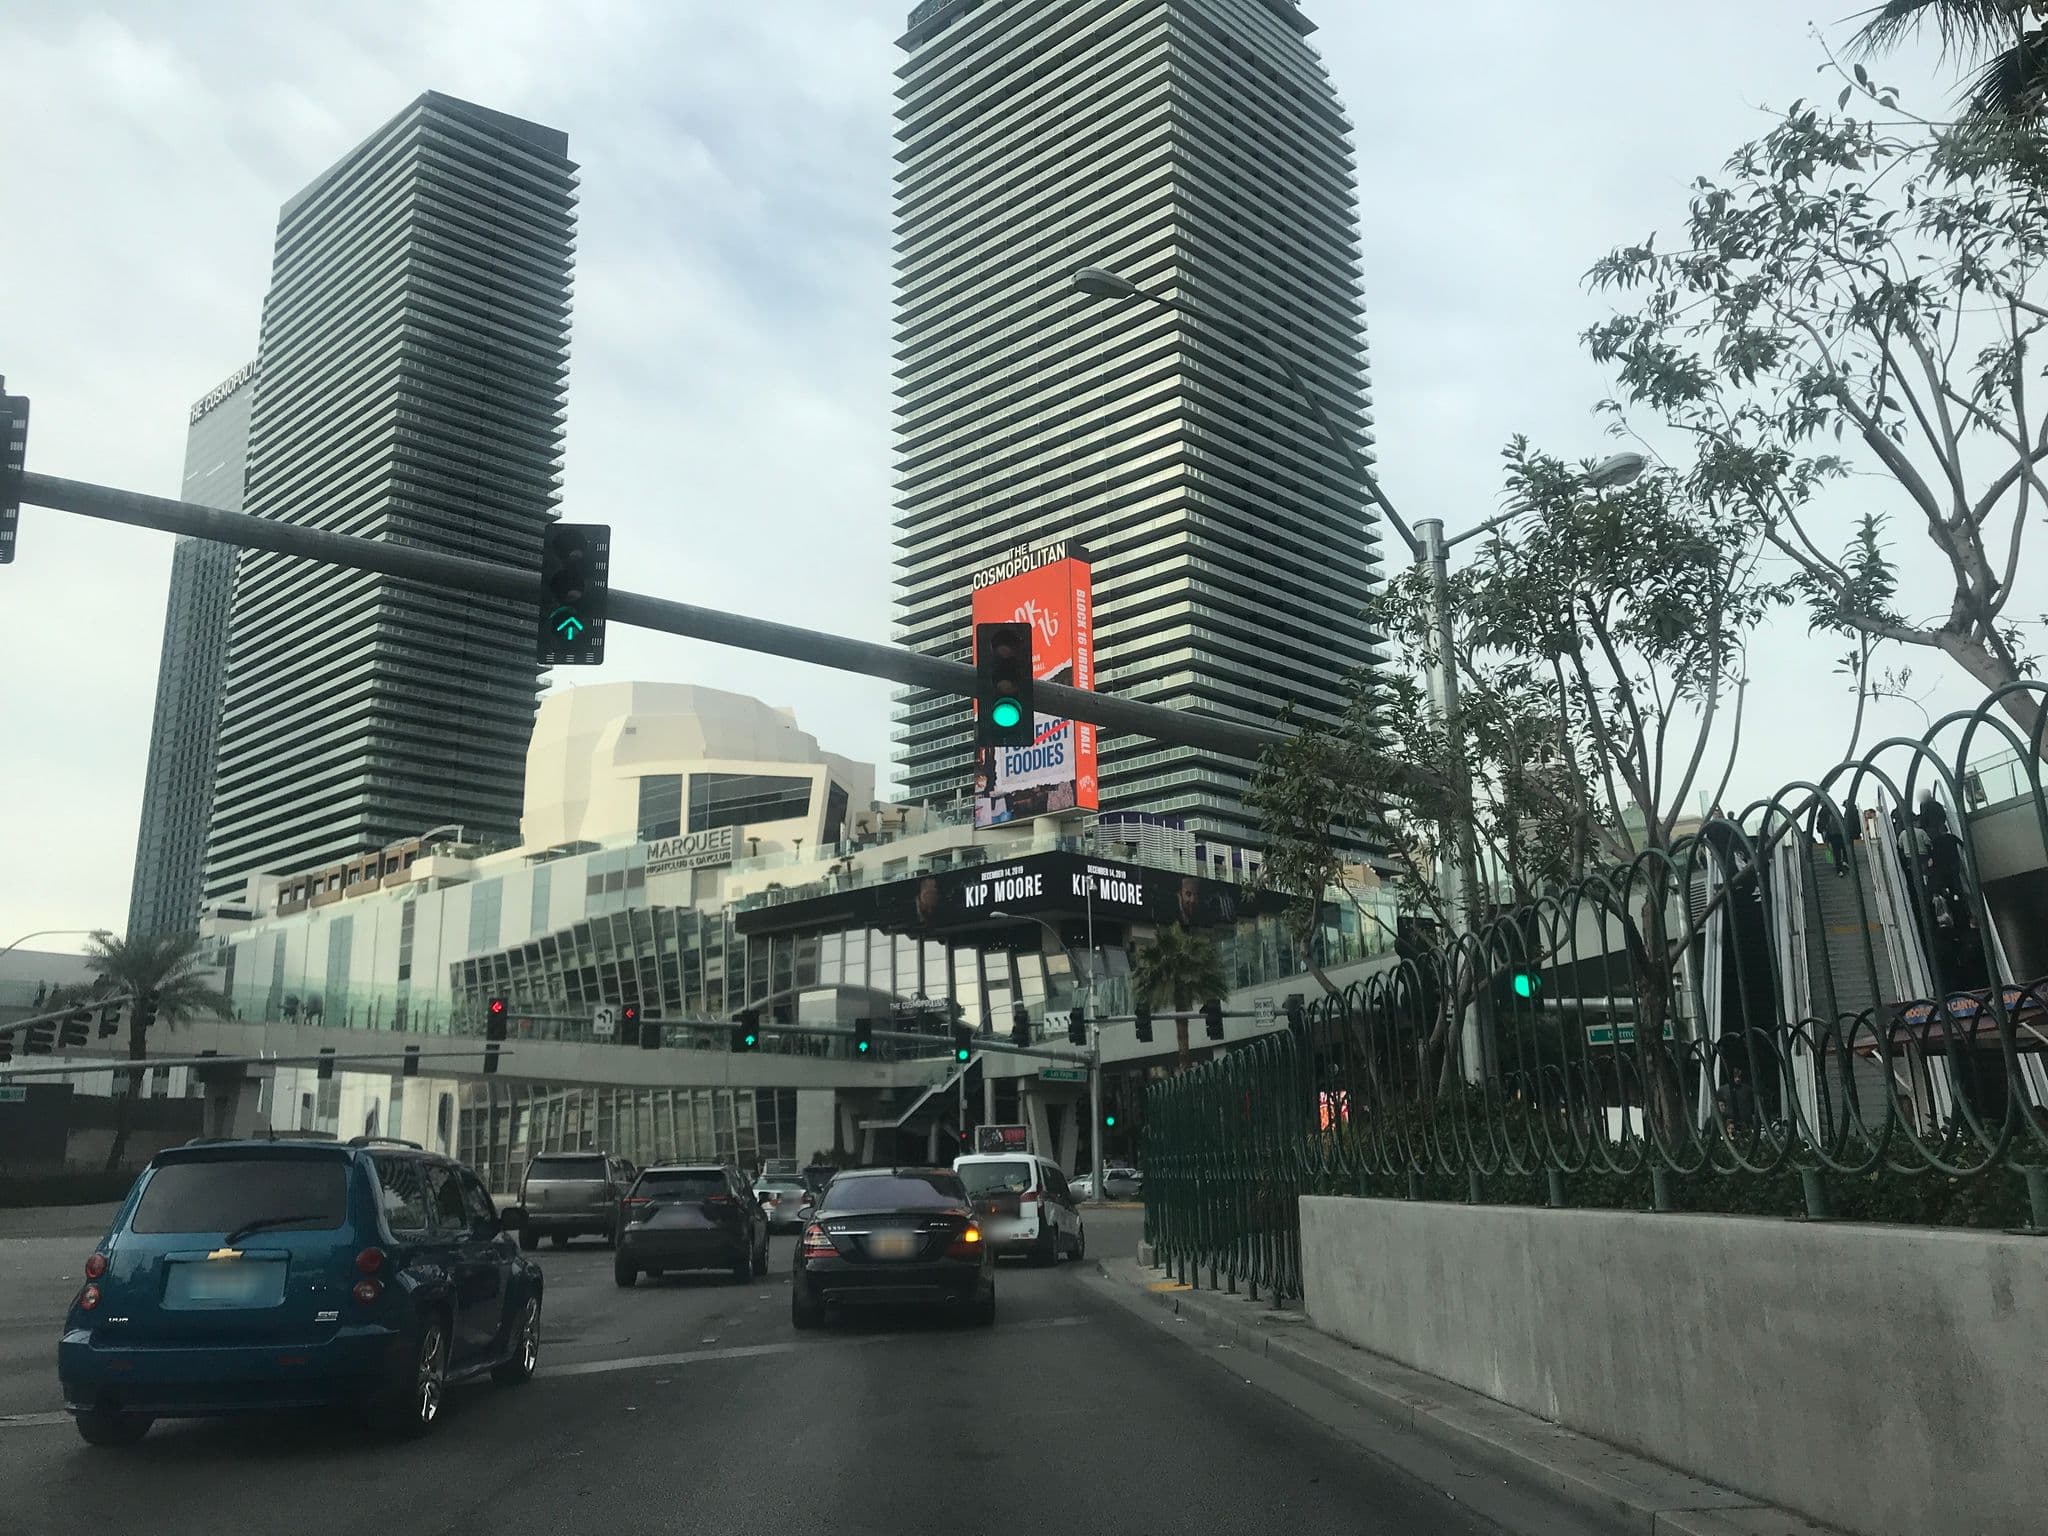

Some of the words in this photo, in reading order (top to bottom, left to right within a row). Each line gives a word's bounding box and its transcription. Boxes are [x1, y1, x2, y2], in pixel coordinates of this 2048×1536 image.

[973, 541, 1066, 590] COSMOPOLITAN
[1009, 543, 1028, 559] THE
[1076, 588, 1087, 629] BLOCK
[1078, 647, 1089, 690] URBAN
[1005, 742, 1064, 777] FOODIES
[647, 828, 732, 860] MARQUEE
[981, 869, 1004, 881] DECEMBER
[1087, 864, 1109, 876] DECEMBER
[966, 884, 988, 908] KIP
[994, 873, 1043, 903] MOORE
[1100, 878, 1143, 906] MOORE
